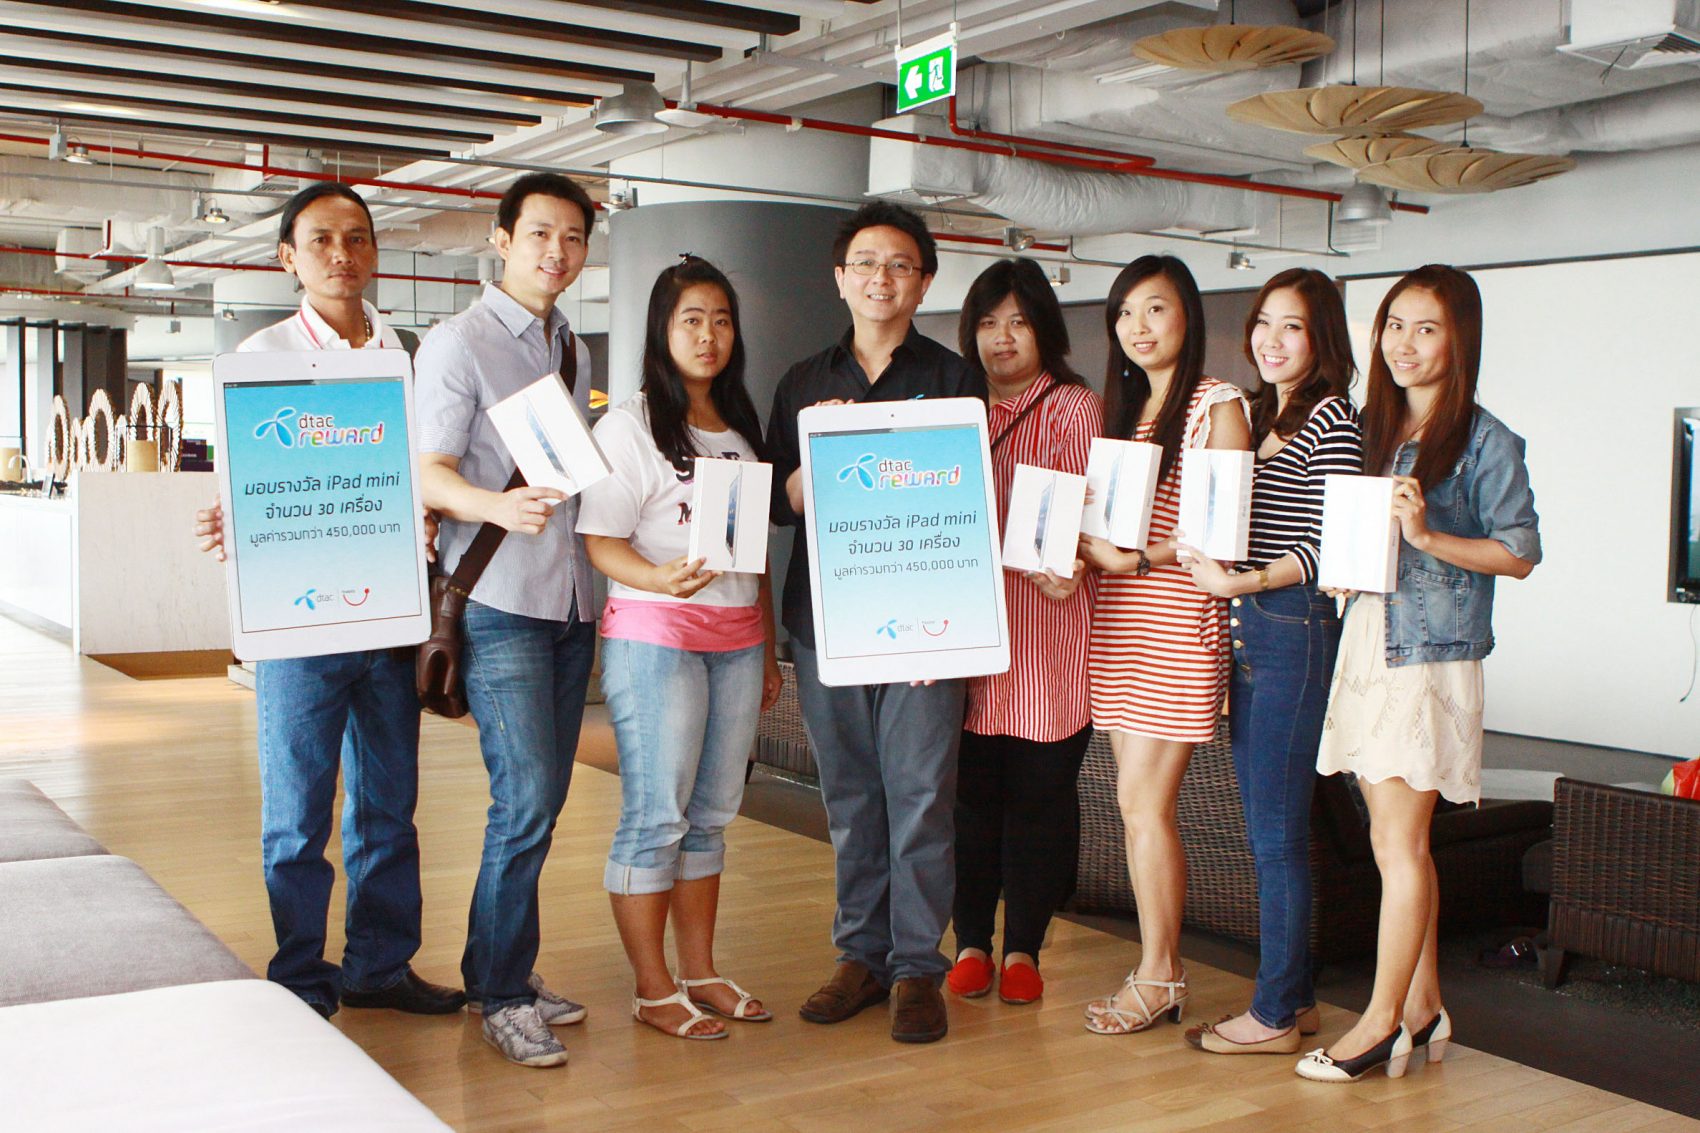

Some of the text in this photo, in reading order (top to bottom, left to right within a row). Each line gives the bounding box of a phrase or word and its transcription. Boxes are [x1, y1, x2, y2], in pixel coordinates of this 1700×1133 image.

[298, 414, 334, 429] dtac
[878, 459, 912, 473] dtac
[244, 471, 400, 496] มอบรางวัล iPad mini
[265, 493, 383, 519] จำนวน 30 เครื่อง
[828, 510, 977, 533] มอบรางวัล iPad mini
[249, 522, 401, 548] มูลค่ารวมกว่า 450,000 บาท
[848, 531, 961, 555] จำนวน 30 เครื่อง
[834, 557, 979, 581] มูลค่ารวมกว่า 450,000 บาท
